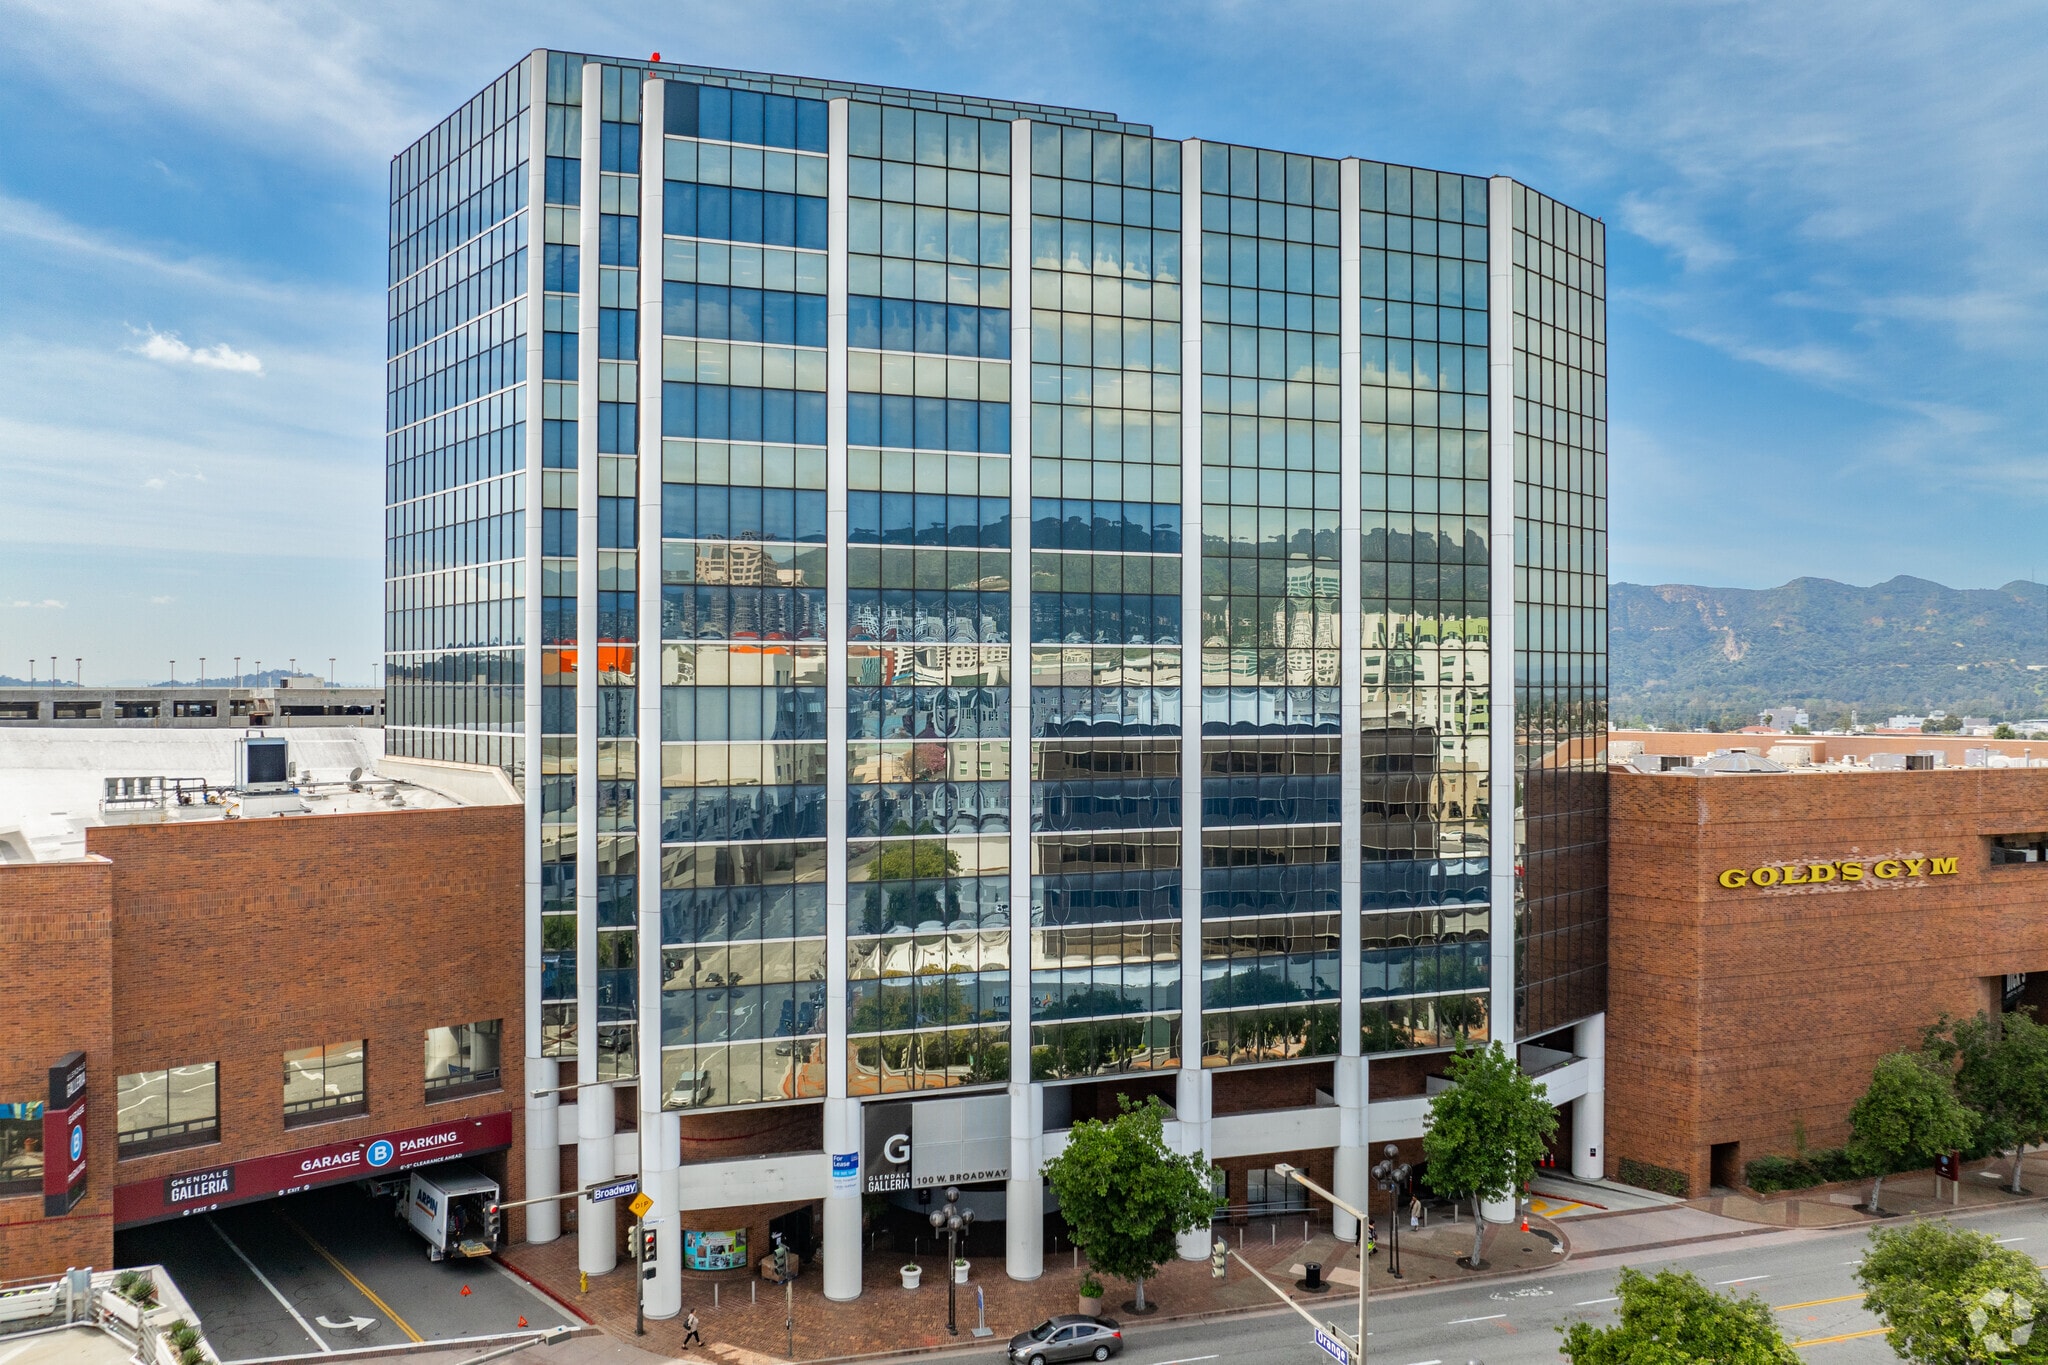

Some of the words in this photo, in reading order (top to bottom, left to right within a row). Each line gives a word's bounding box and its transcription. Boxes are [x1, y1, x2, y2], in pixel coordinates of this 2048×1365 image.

[1719, 861, 1864, 888] GOLD'S
[1874, 857, 1959, 879] GYM
[73, 1133, 80, 1154] B
[301, 1150, 360, 1171] GARAGE
[374, 1145, 388, 1161] B
[400, 1131, 457, 1152] PARKING
[884, 1134, 910, 1163] G
[413, 1156, 444, 1168] CLEARANCE
[444, 1153, 463, 1161] AHEAD
[171, 1169, 228, 1187] GLENDALE
[868, 1172, 910, 1181] GLENDALE
[917, 1176, 934, 1185] 100
[937, 1175, 947, 1183] W.
[950, 1169, 1008, 1182] BROADWAY
[171, 1178, 228, 1202] GALLERIA
[287, 1186, 301, 1194] EXIT
[595, 1183, 636, 1199] Broadway
[868, 1178, 910, 1193] GALLERIA
[193, 1206, 208, 1214] EXIT
[417, 1189, 438, 1216] ARPIN
[635, 1201, 649, 1209] DIP
[1318, 1330, 1346, 1360] Orange
